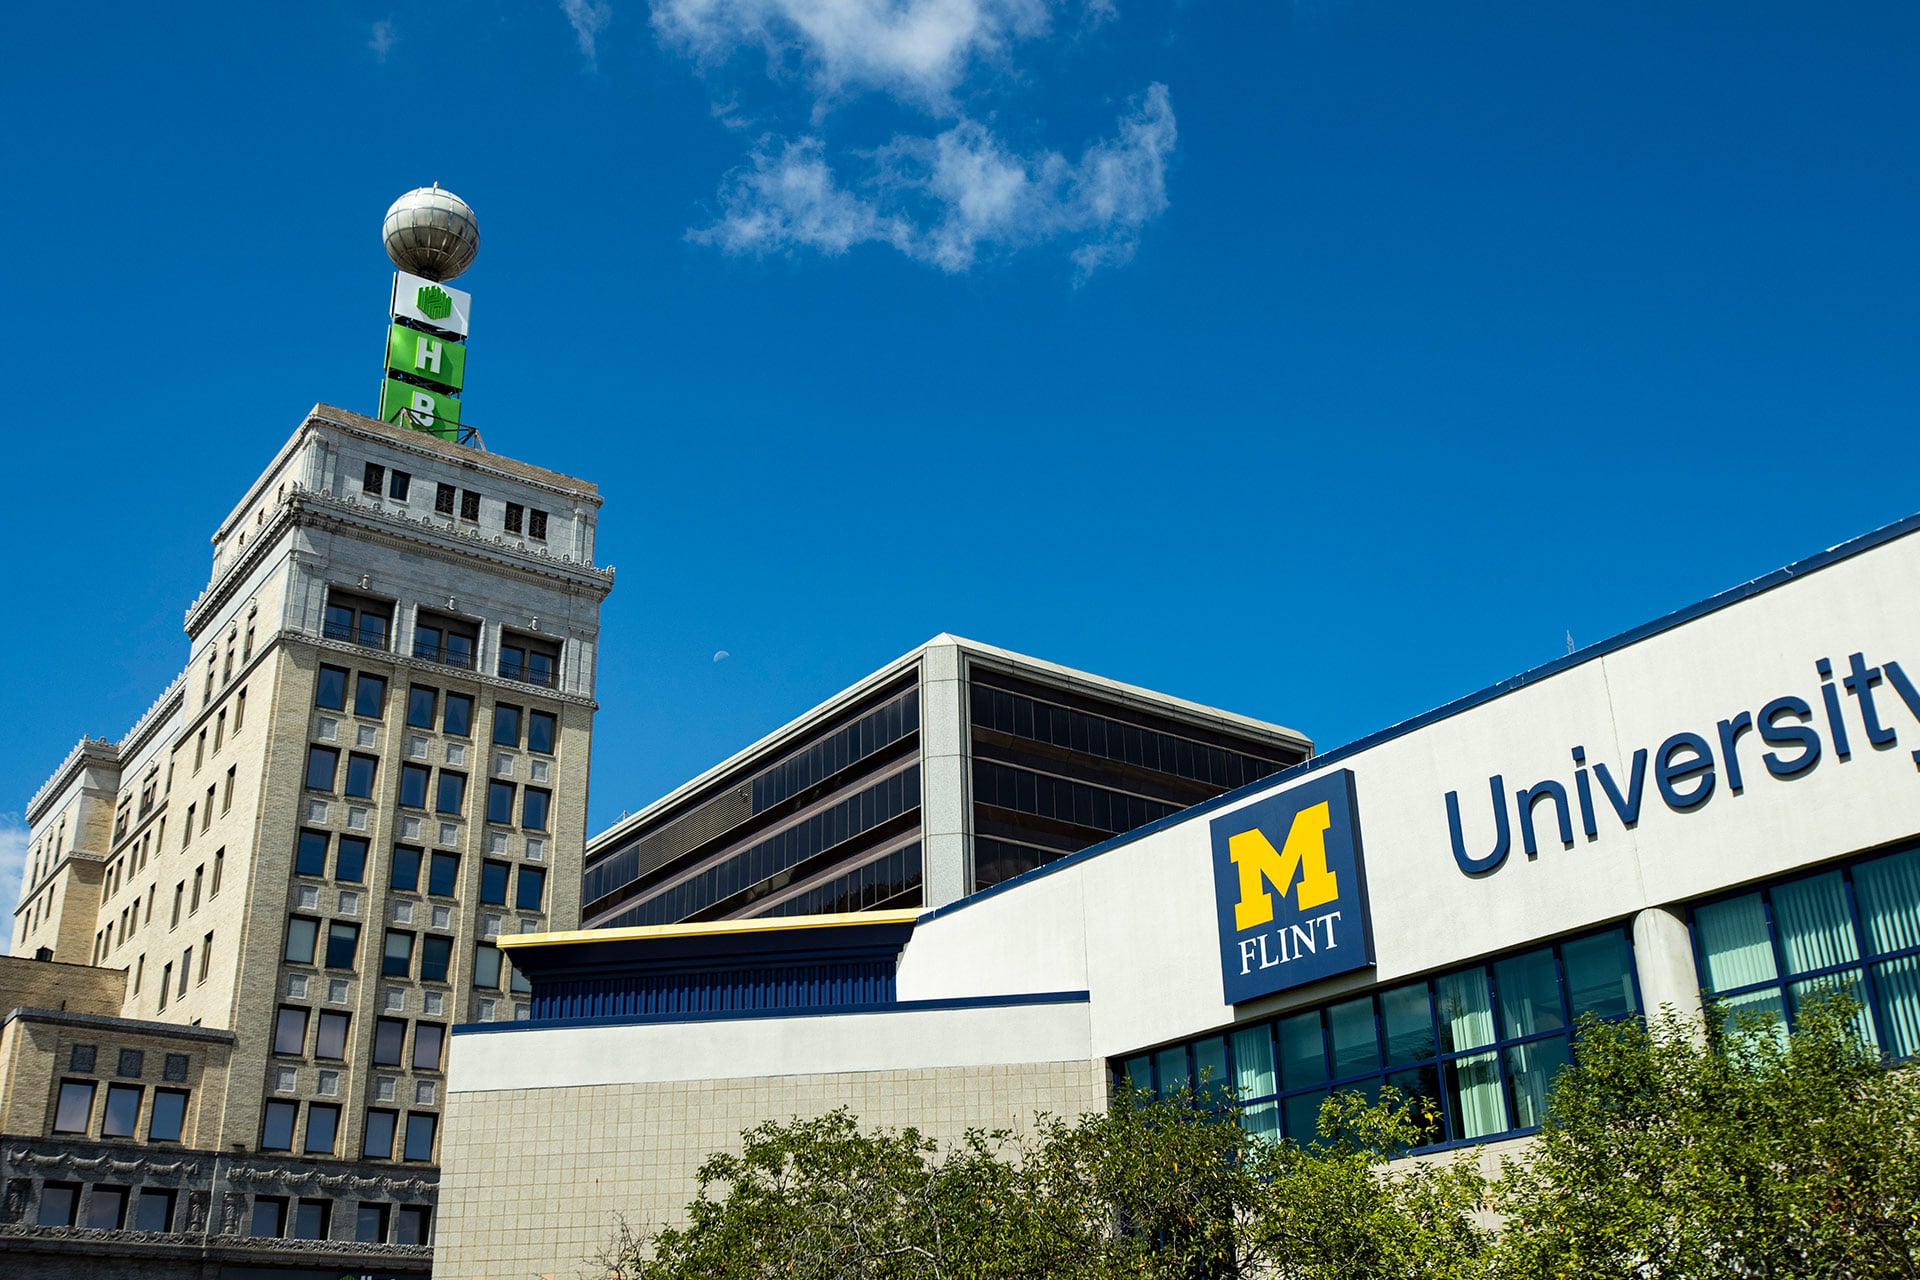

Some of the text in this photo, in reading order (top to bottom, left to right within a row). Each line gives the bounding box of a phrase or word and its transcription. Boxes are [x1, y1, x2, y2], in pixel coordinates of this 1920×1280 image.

[415, 336, 442, 374] H
[411, 391, 436, 427] B
[1228, 800, 1339, 931] M
[1237, 911, 1341, 976] FLINT
